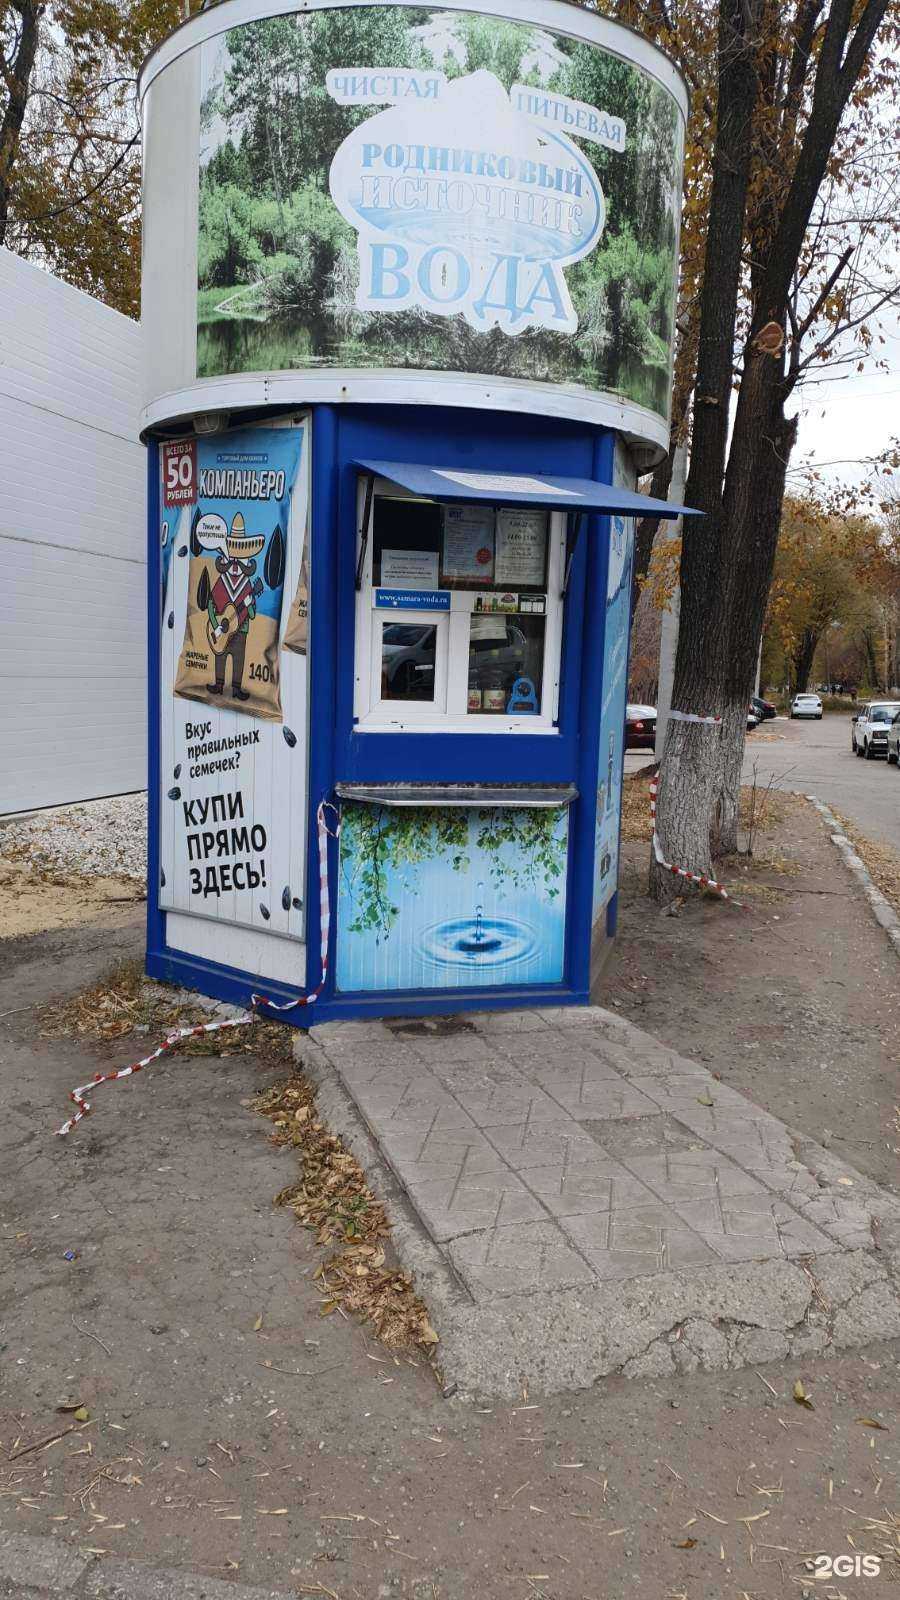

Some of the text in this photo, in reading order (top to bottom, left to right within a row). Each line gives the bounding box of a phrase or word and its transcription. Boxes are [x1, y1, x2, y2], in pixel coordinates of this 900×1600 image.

[333, 75, 622, 143] ЧИСТАЯ ПИТЬЕВАЯ
[360, 143, 584, 198] РОДНИКОВЫЙ
[359, 175, 583, 238] ИСТОЧНИК
[366, 243, 570, 324] ВОДА
[166, 444, 193, 456] ВСЕГО ЗА
[166, 455, 193, 489] 50
[199, 468, 286, 501] КОМПАНЬЕРО
[166, 486, 193, 500] РУБЛЕЙ
[185, 659, 208, 670] СЕМЕЧКИ
[185, 721, 212, 740] Вкус
[187, 729, 260, 762] правильных
[189, 751, 241, 779] семечек?
[183, 791, 245, 827] КУПИ
[186, 823, 268, 861] ПРЯМО
[189, 859, 267, 898] ЗДЕСЬ!
